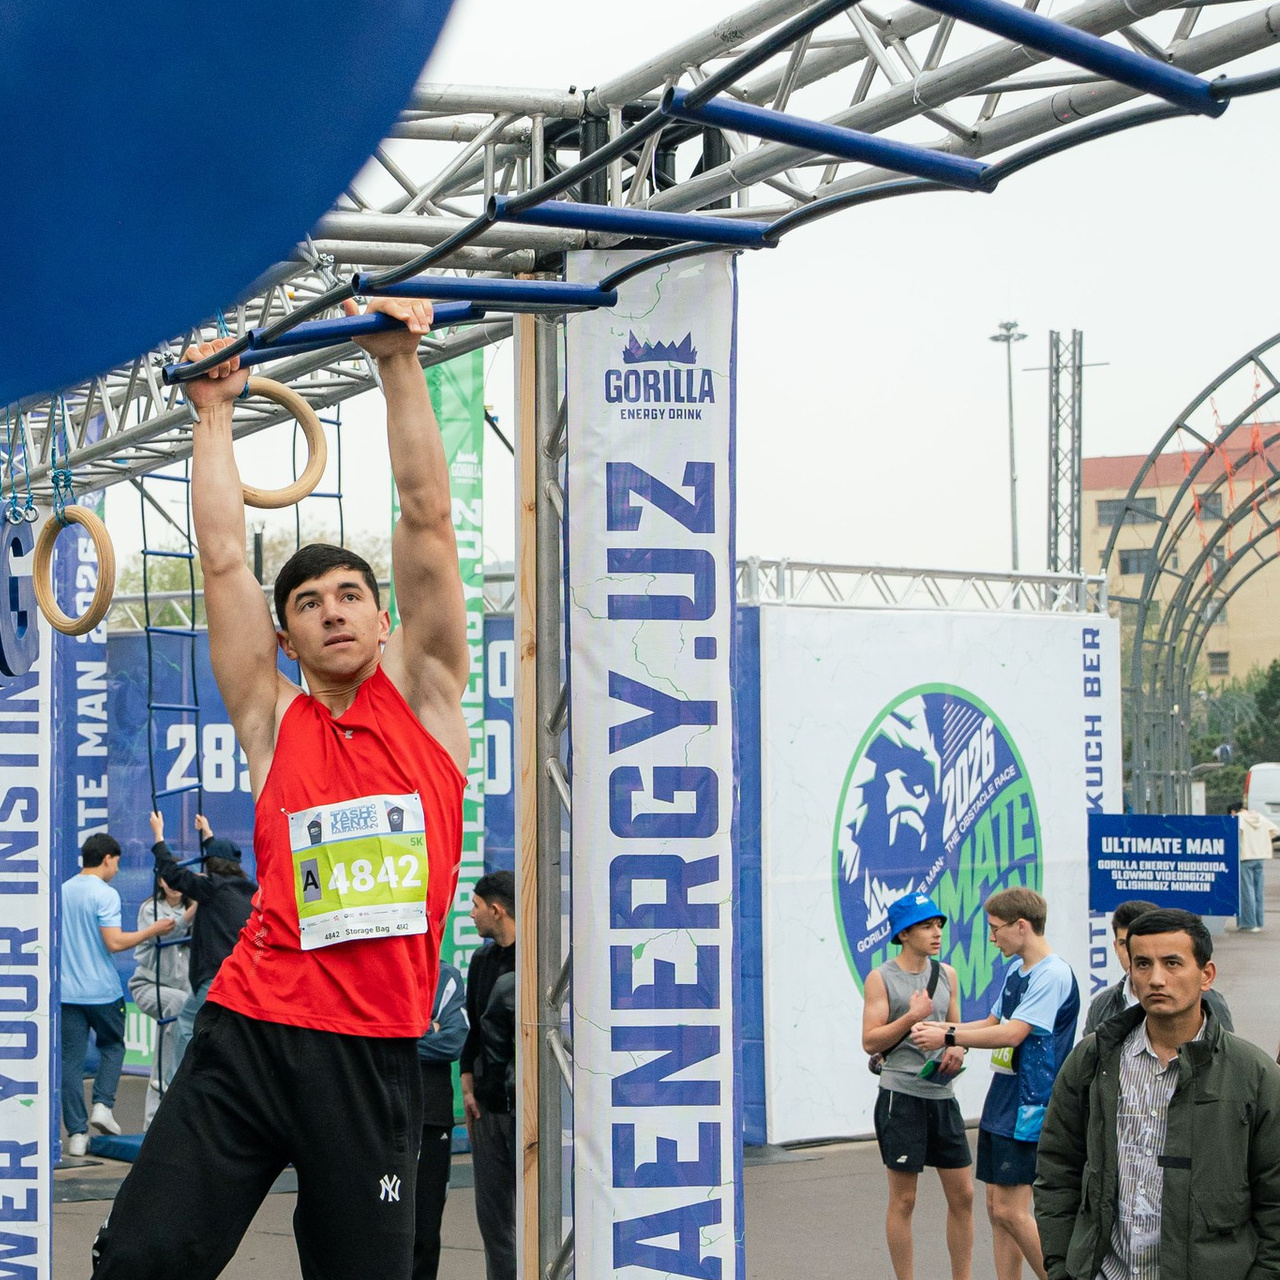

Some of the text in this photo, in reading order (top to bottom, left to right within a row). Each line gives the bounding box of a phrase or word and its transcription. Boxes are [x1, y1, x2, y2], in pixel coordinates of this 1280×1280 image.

[604, 369, 715, 404] GORILLA
[620, 408, 702, 420] ENERGY DRINK
[1082, 628, 1102, 698] BER
[76, 661, 109, 757] MAN
[942, 718, 995, 843] 2026
[330, 807, 370, 823] TASH
[944, 831, 961, 854] THE
[958, 781, 995, 834] OBSTACLE
[994, 764, 1016, 793] RACE
[331, 817, 369, 832] KENT
[410, 836, 424, 847] 5K
[1101, 836, 1225, 855] ULTIMATE MAN
[1098, 859, 1137, 870] GORILLA
[1139, 860, 1176, 871] ENERGY
[303, 854, 422, 895] A 4842
[1111, 870, 1154, 880] SLOWMO
[1116, 880, 1211, 892] OLISHINGIZ MUMKIN
[325, 923, 409, 940] 4842 Storage Bag 4842
